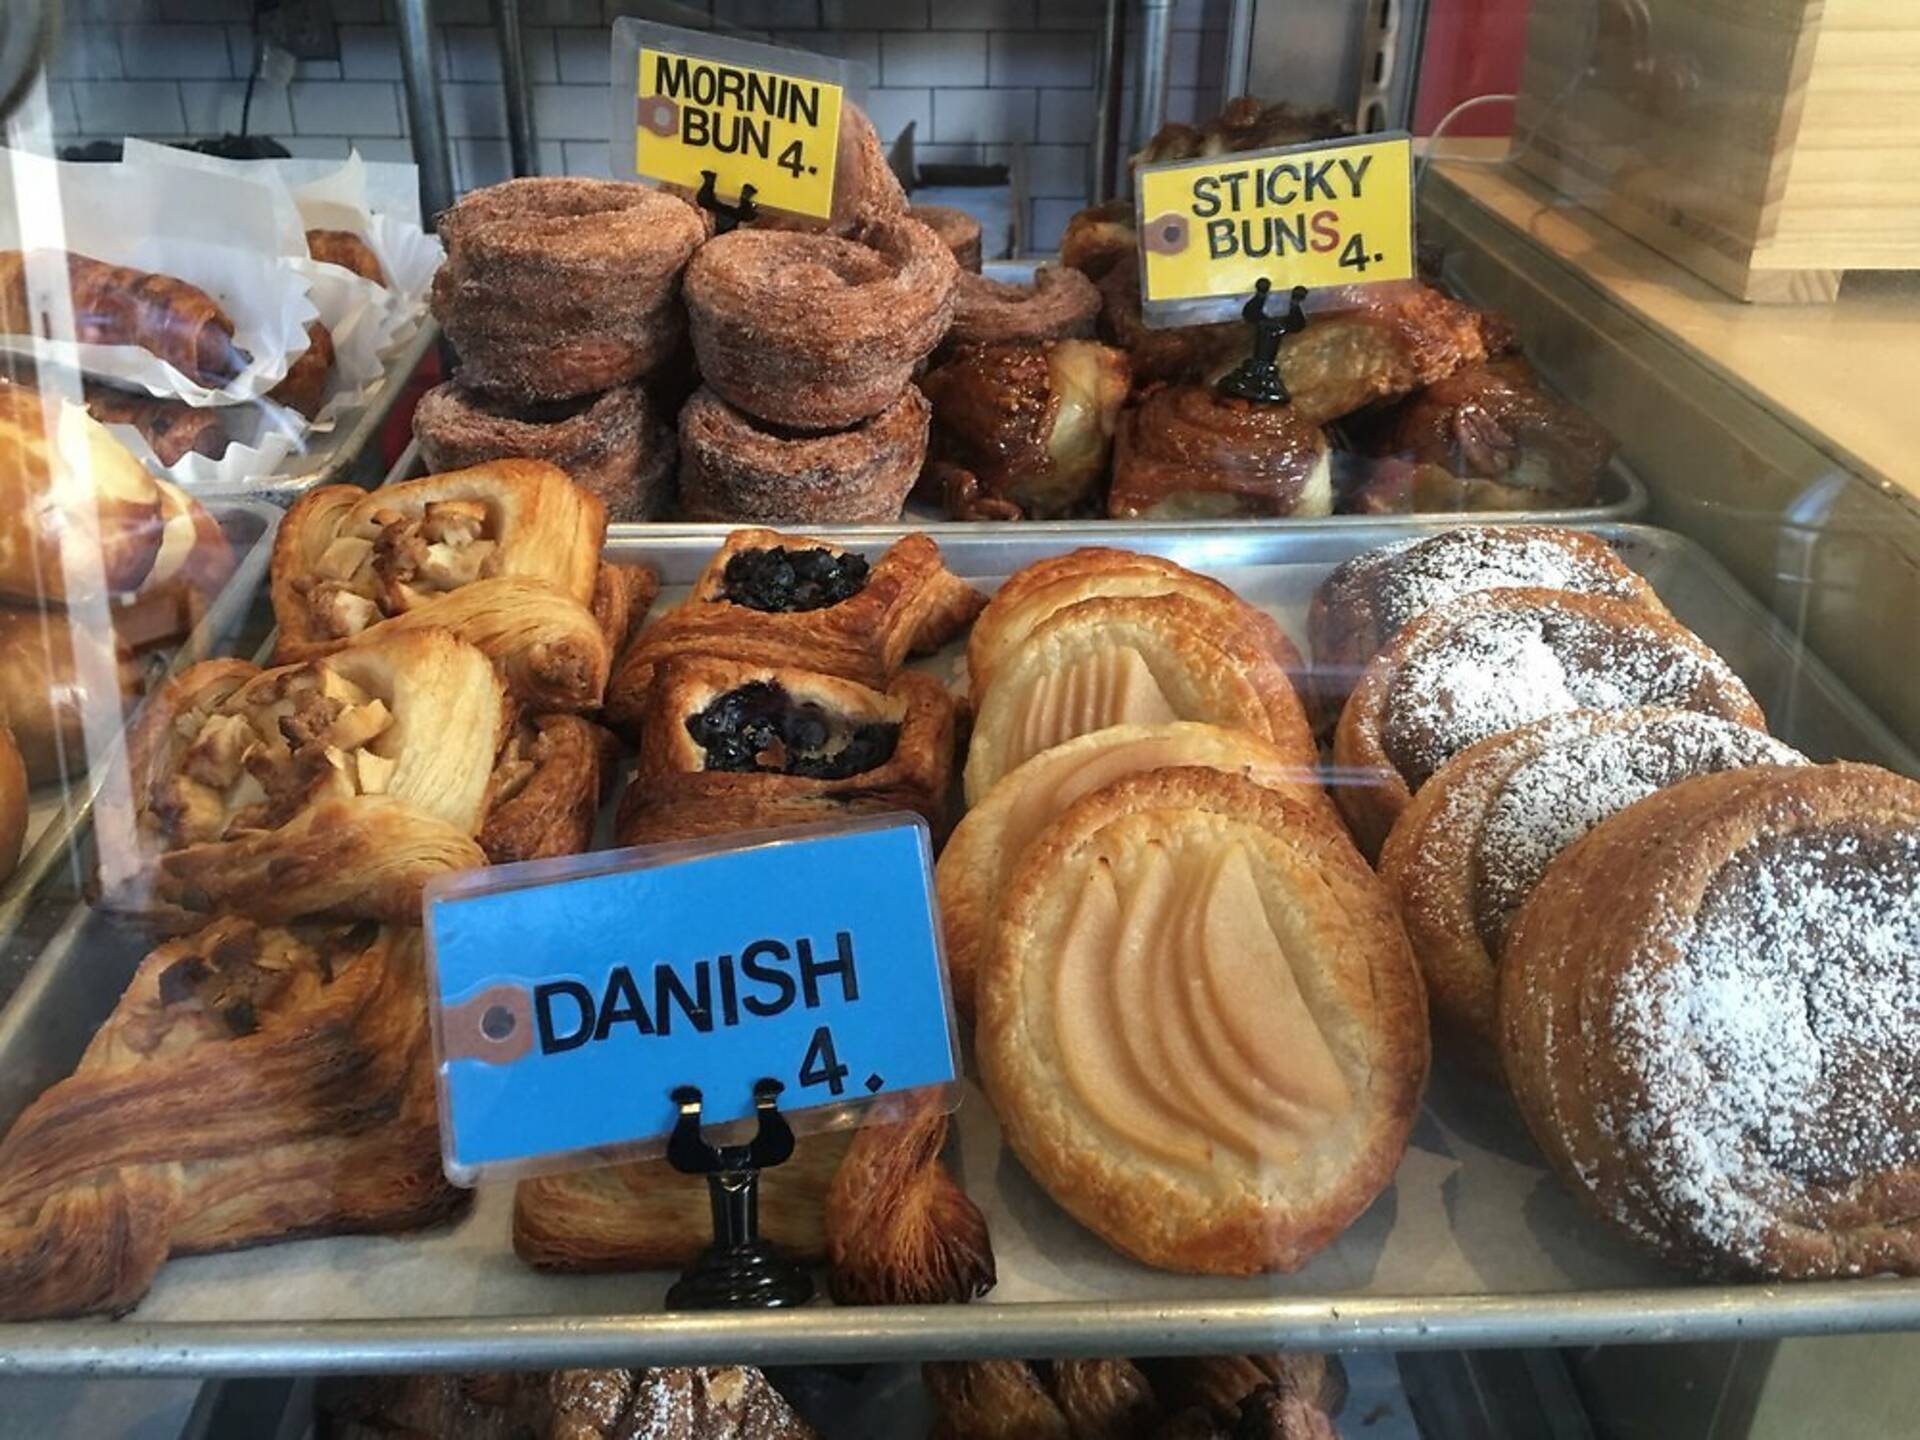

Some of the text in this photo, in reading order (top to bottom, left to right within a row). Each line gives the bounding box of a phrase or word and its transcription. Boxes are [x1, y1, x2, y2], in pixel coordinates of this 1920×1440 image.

[654, 56, 819, 127] MORNIN
[682, 106, 818, 178] BUN 4.
[1192, 155, 1372, 217] STICKY
[1207, 210, 1383, 272] BUNS 4.
[533, 931, 859, 1055] DANISH
